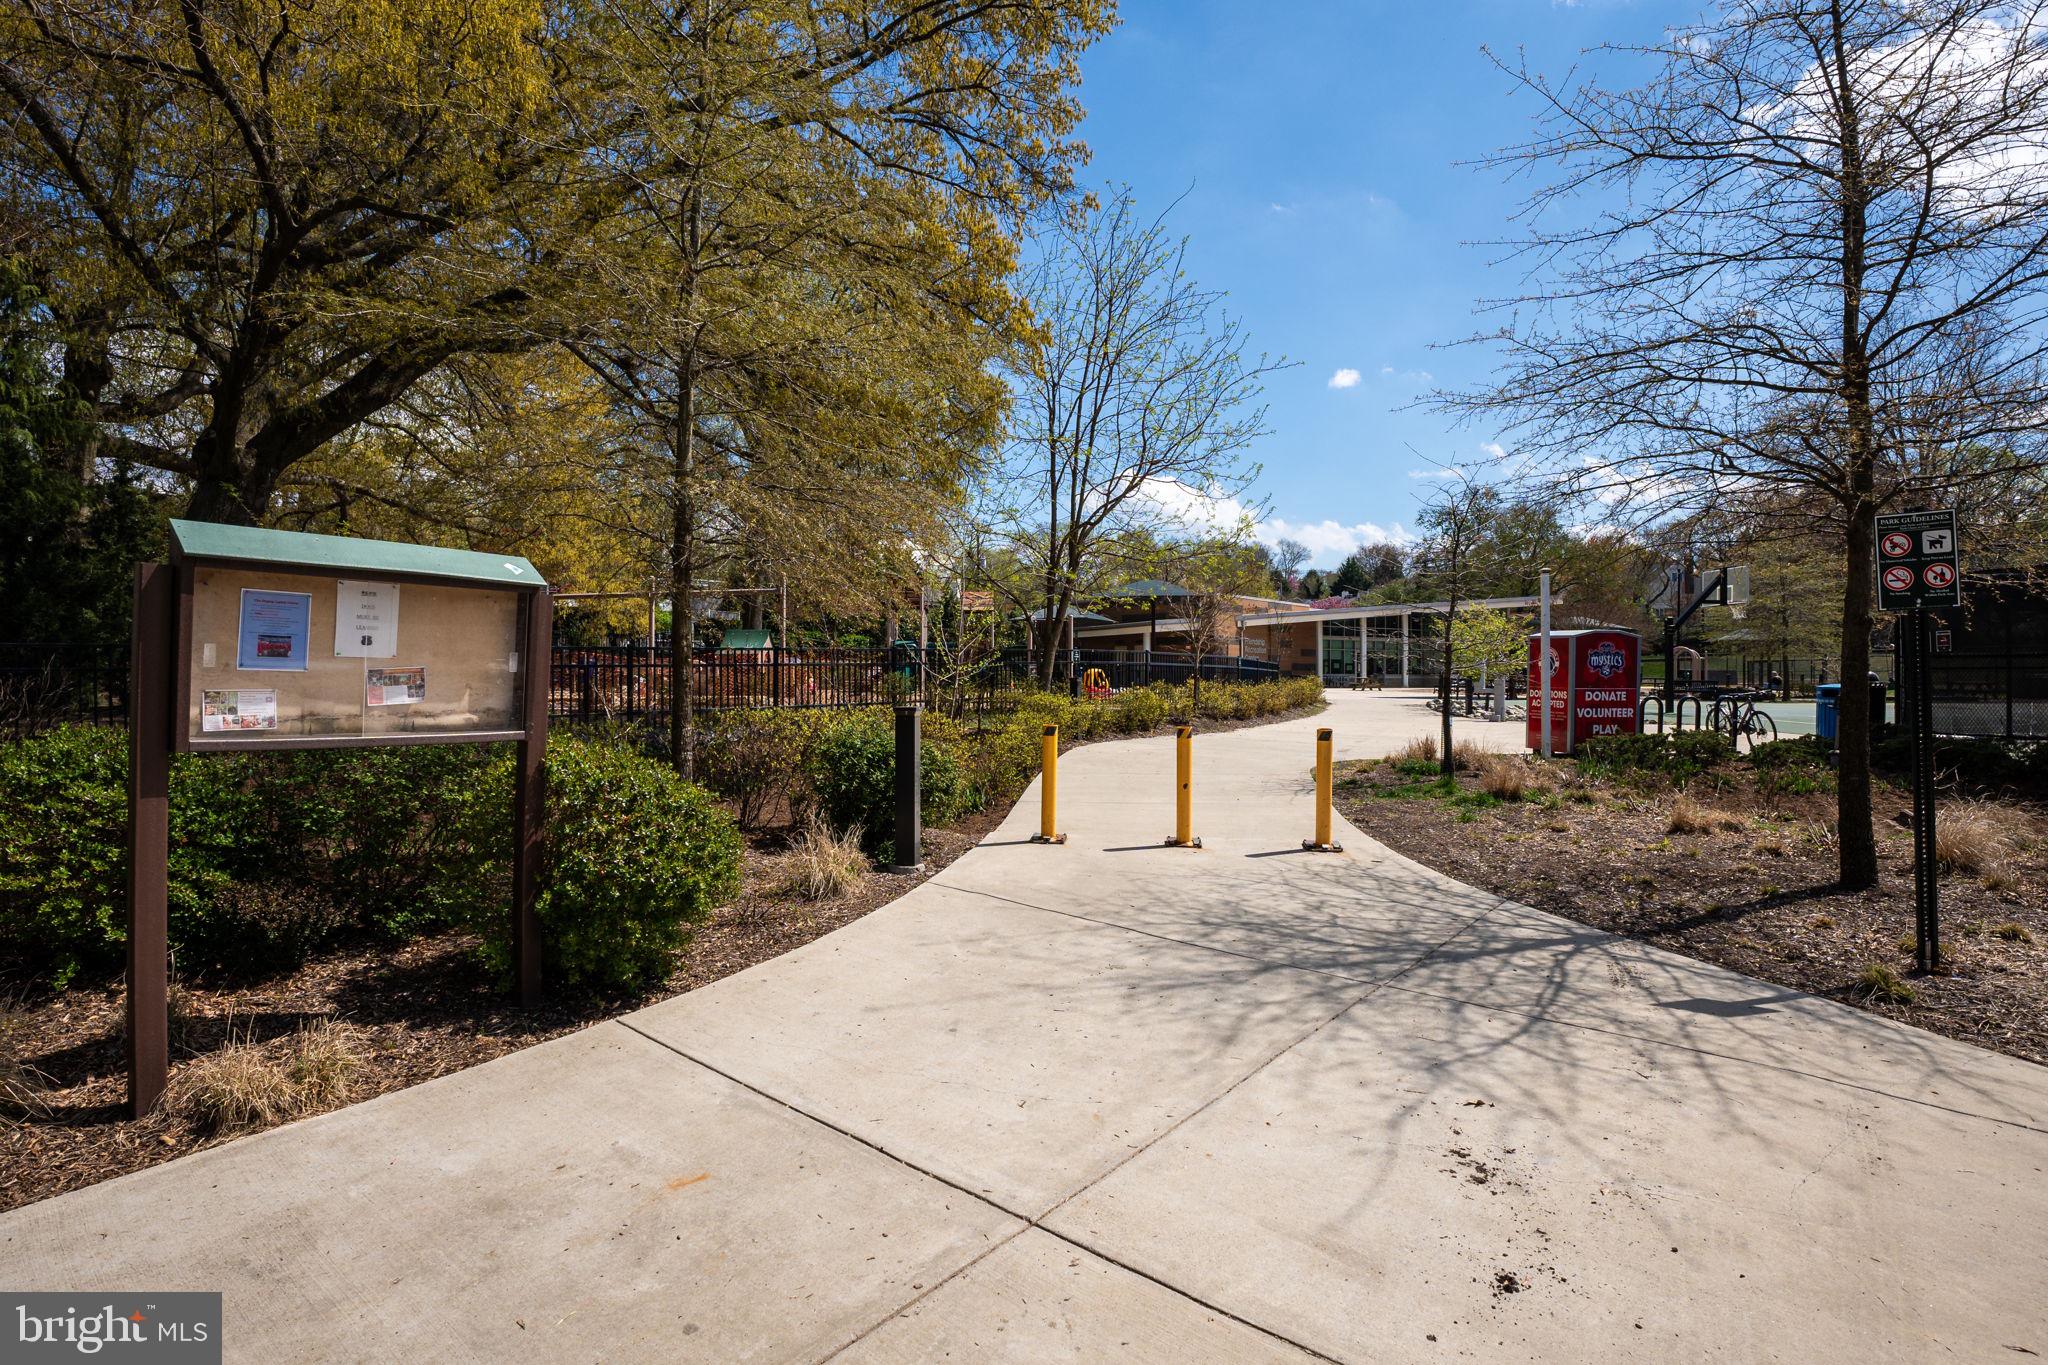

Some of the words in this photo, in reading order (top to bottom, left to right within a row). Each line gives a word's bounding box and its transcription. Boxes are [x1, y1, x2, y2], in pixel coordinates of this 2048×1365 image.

[1901, 514, 1950, 523] GUIDELINES
[1529, 689, 1568, 700] DONIONS
[1585, 691, 1627, 702] DONATE
[1531, 699, 1565, 709] ACPTED
[1577, 707, 1634, 718] VOLUNTEER
[1592, 724, 1618, 734] PLAY
